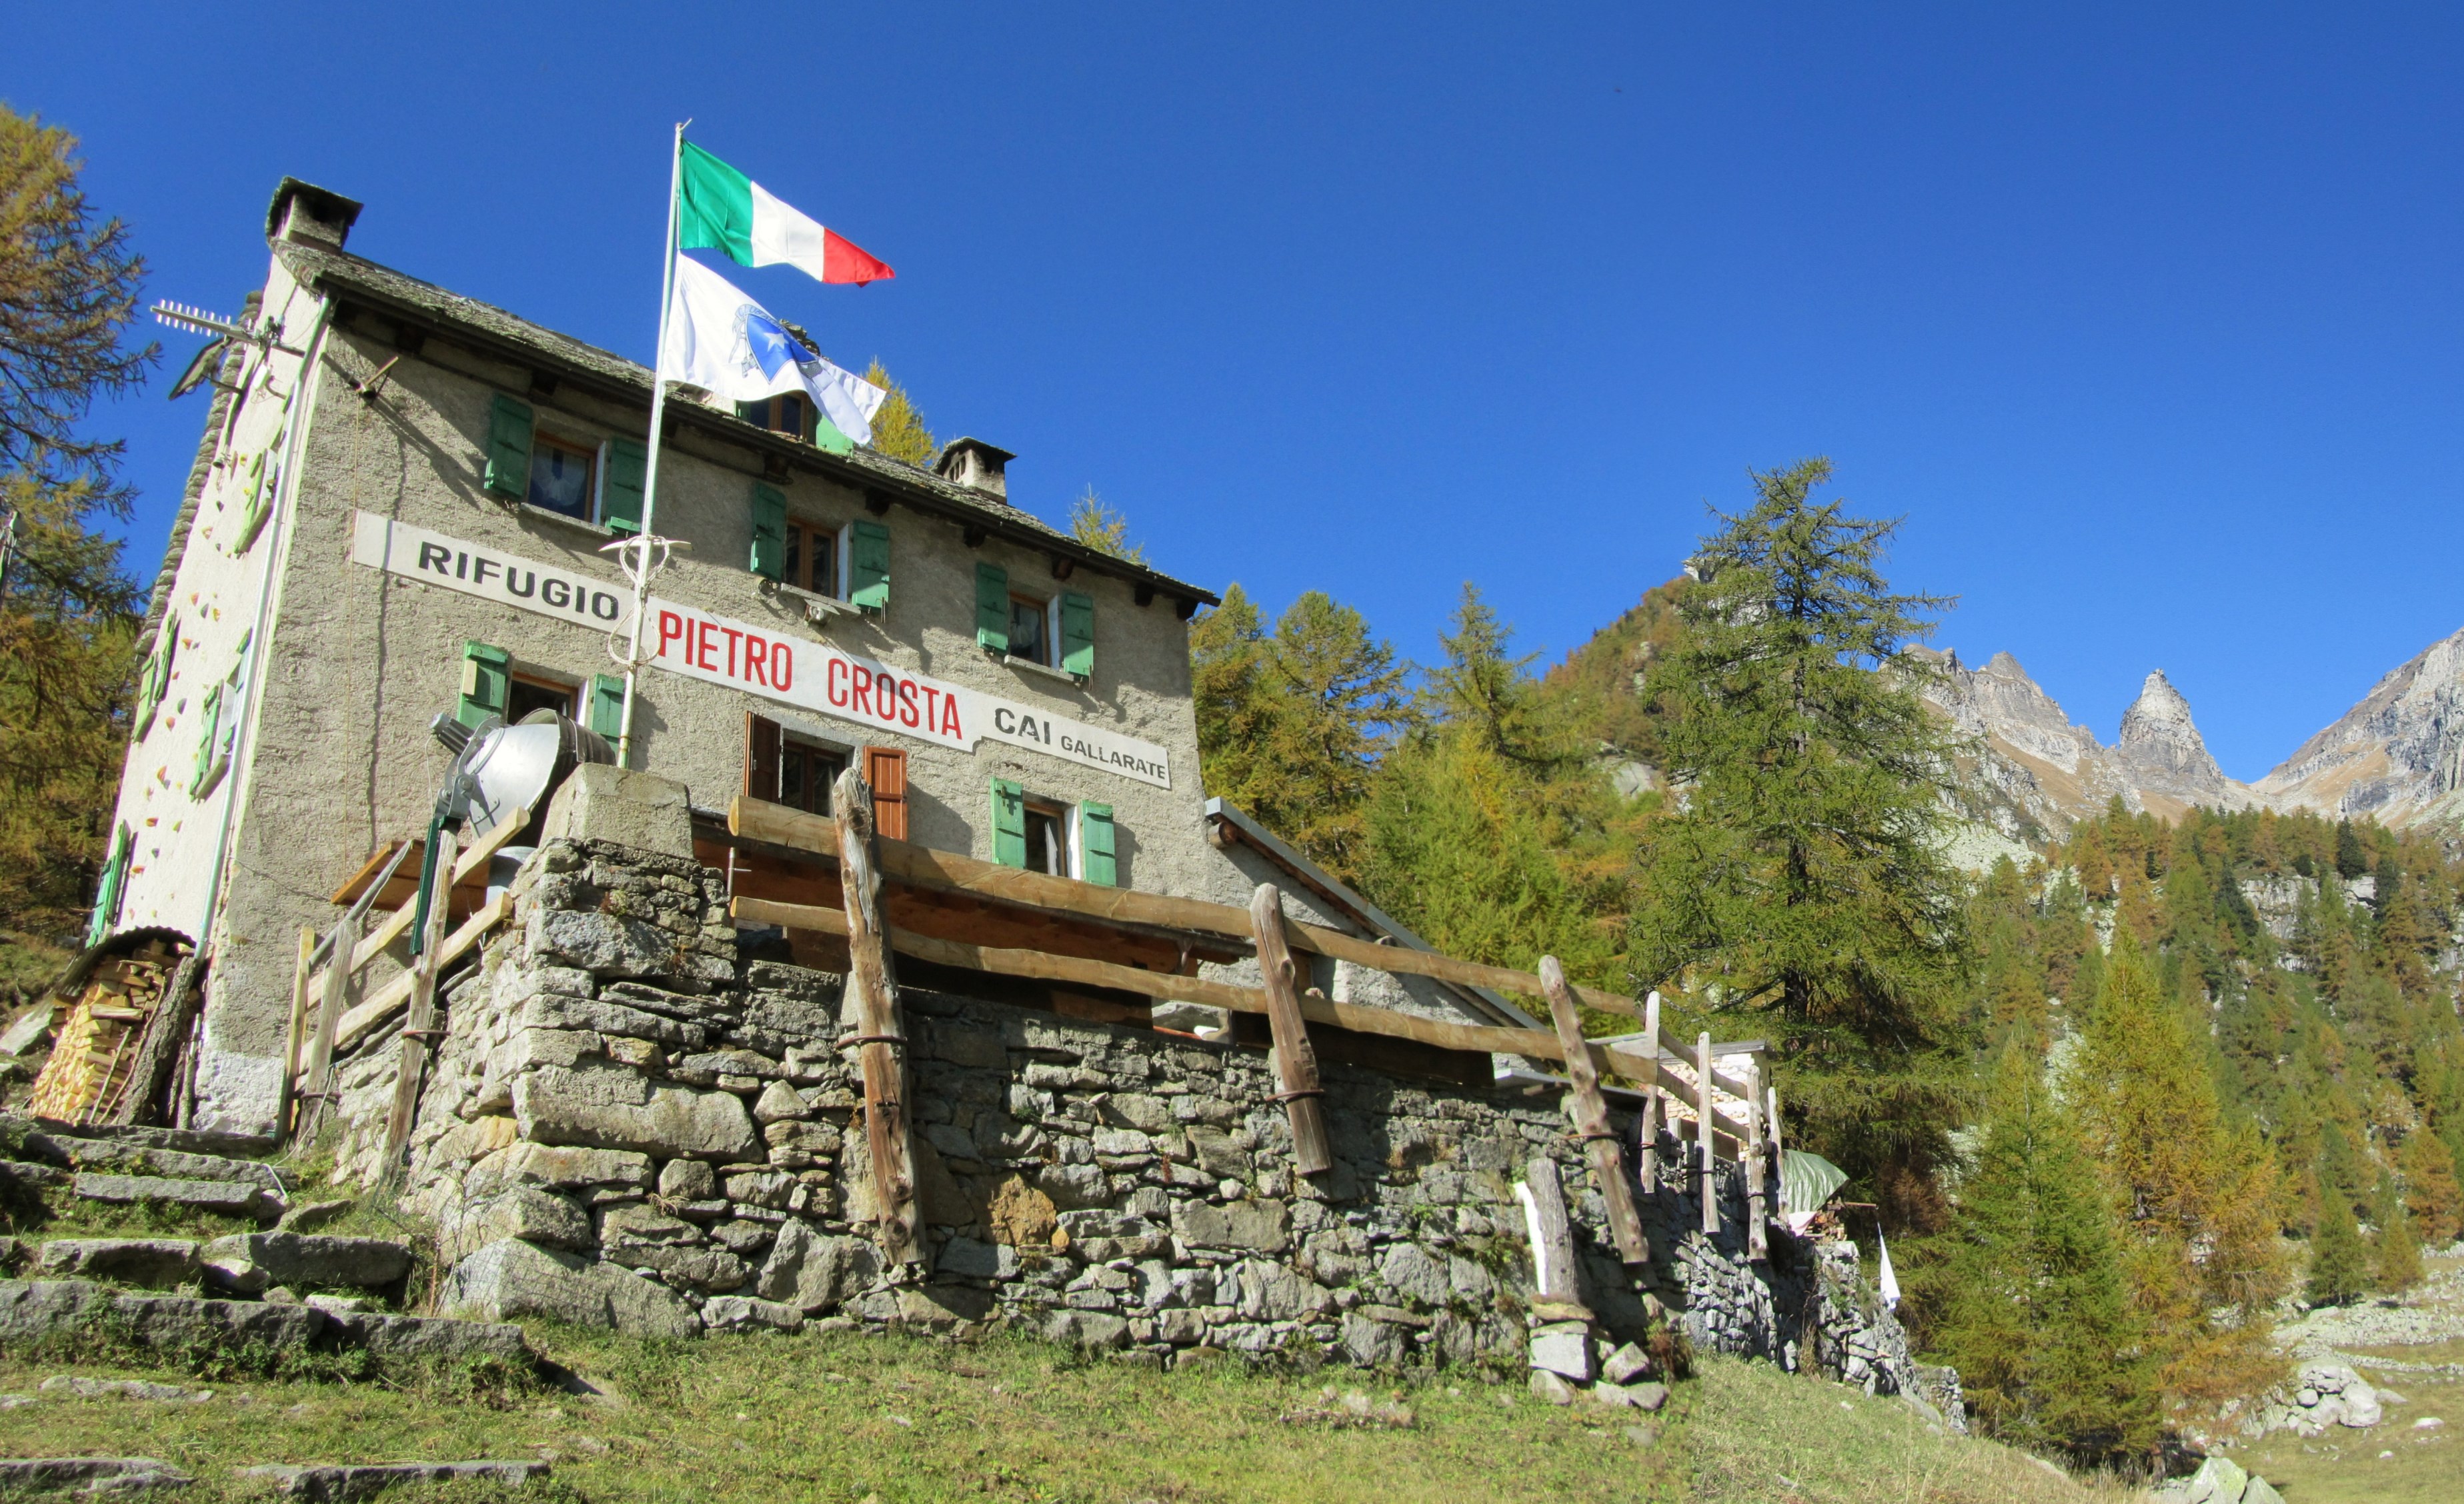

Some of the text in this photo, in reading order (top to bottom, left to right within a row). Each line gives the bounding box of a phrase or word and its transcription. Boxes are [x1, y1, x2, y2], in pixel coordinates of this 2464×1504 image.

[418, 541, 1165, 780] RIFUGIO PIETRO CROSTA CAI GALLARATE
